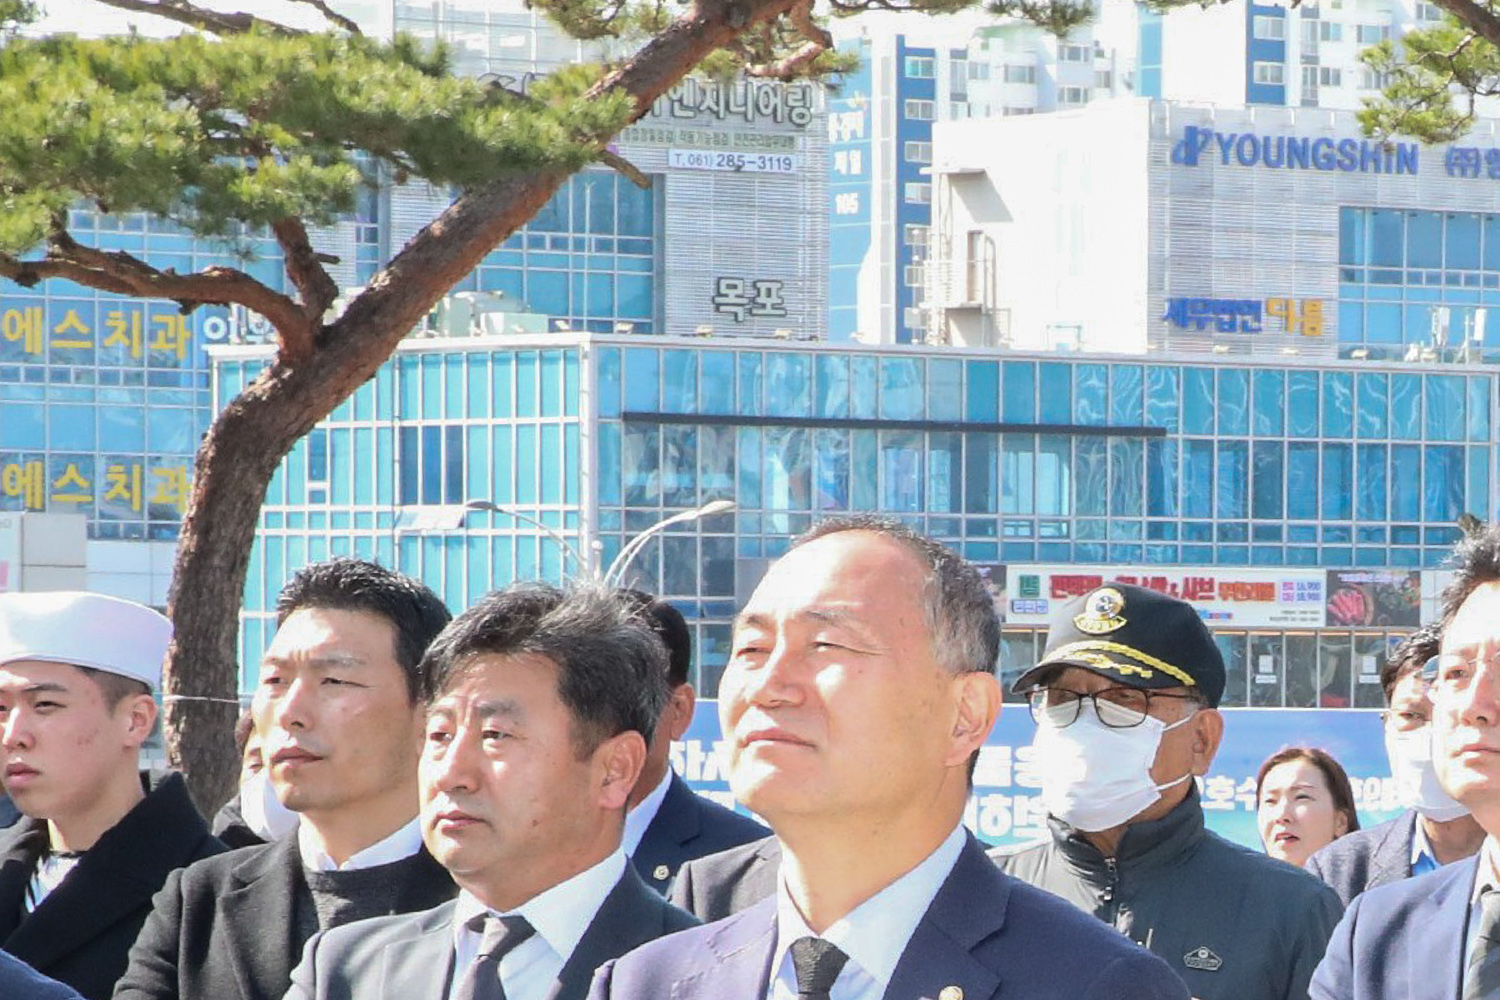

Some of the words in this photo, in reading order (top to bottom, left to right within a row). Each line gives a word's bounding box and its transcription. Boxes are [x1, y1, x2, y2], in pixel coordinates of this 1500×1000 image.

[652, 77, 812, 125] 엔지니어링
[717, 154, 792, 171] 285-3119
[1215, 133, 1419, 175] YOUNGSHIN
[713, 276, 787, 322] 목포
